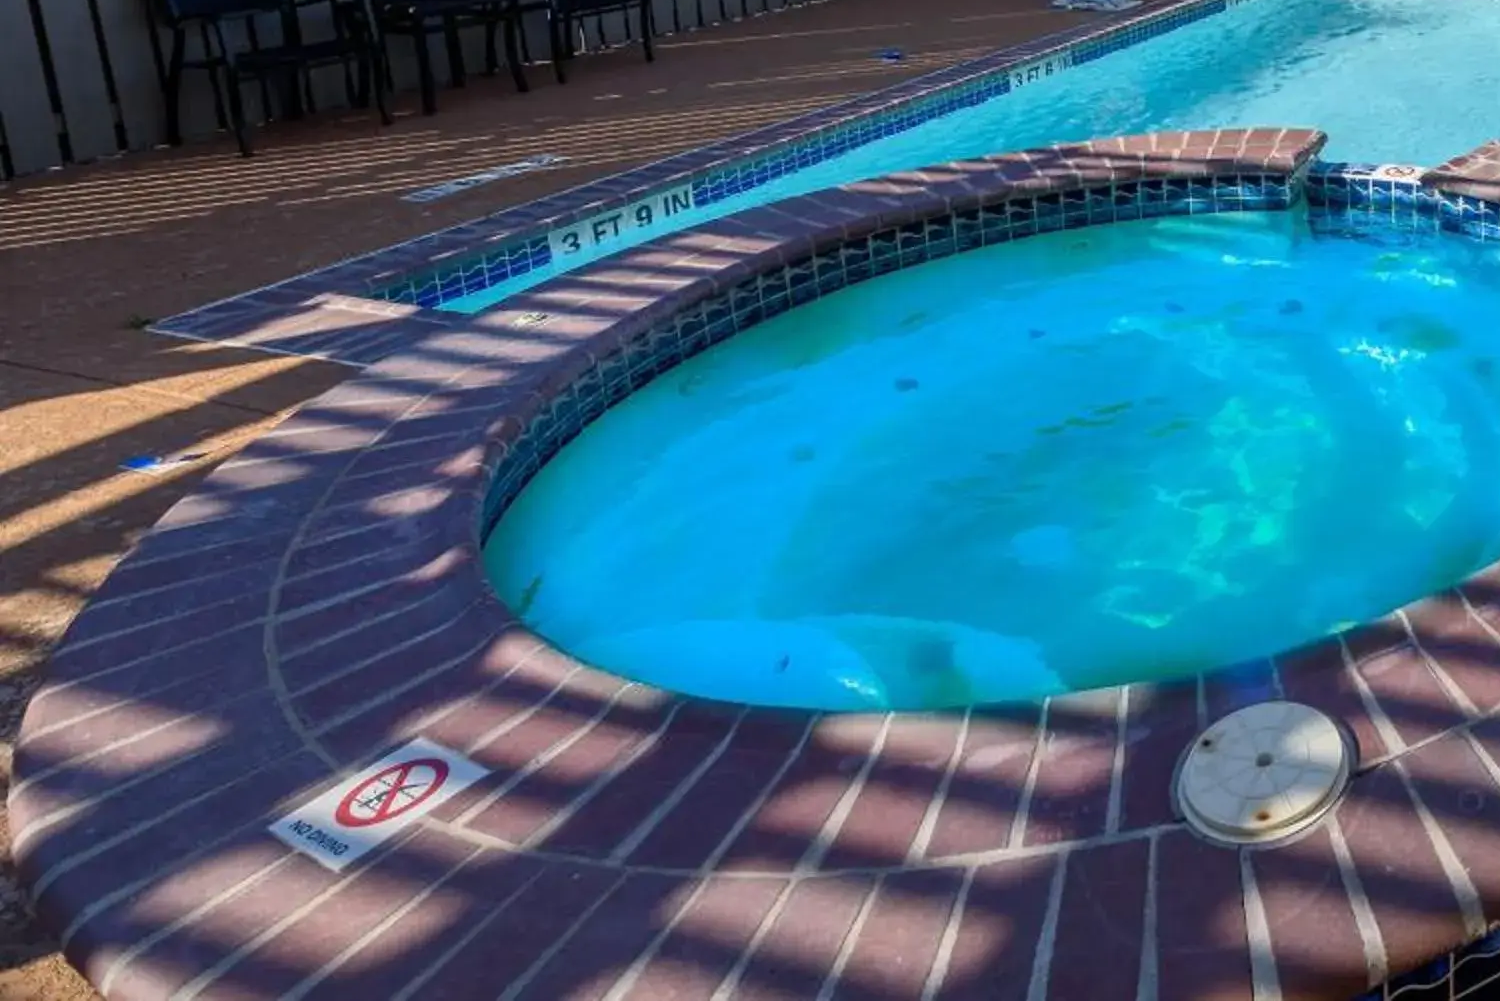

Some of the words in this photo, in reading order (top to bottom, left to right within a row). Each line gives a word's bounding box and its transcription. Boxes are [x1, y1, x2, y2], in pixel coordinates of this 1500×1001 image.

[1015, 72, 1023, 87] 3
[1027, 65, 1040, 83] FT
[562, 232, 580, 255] 3
[592, 213, 622, 245] FT
[636, 205, 652, 227] 9
[663, 190, 690, 217] IN
[288, 819, 312, 836] NO
